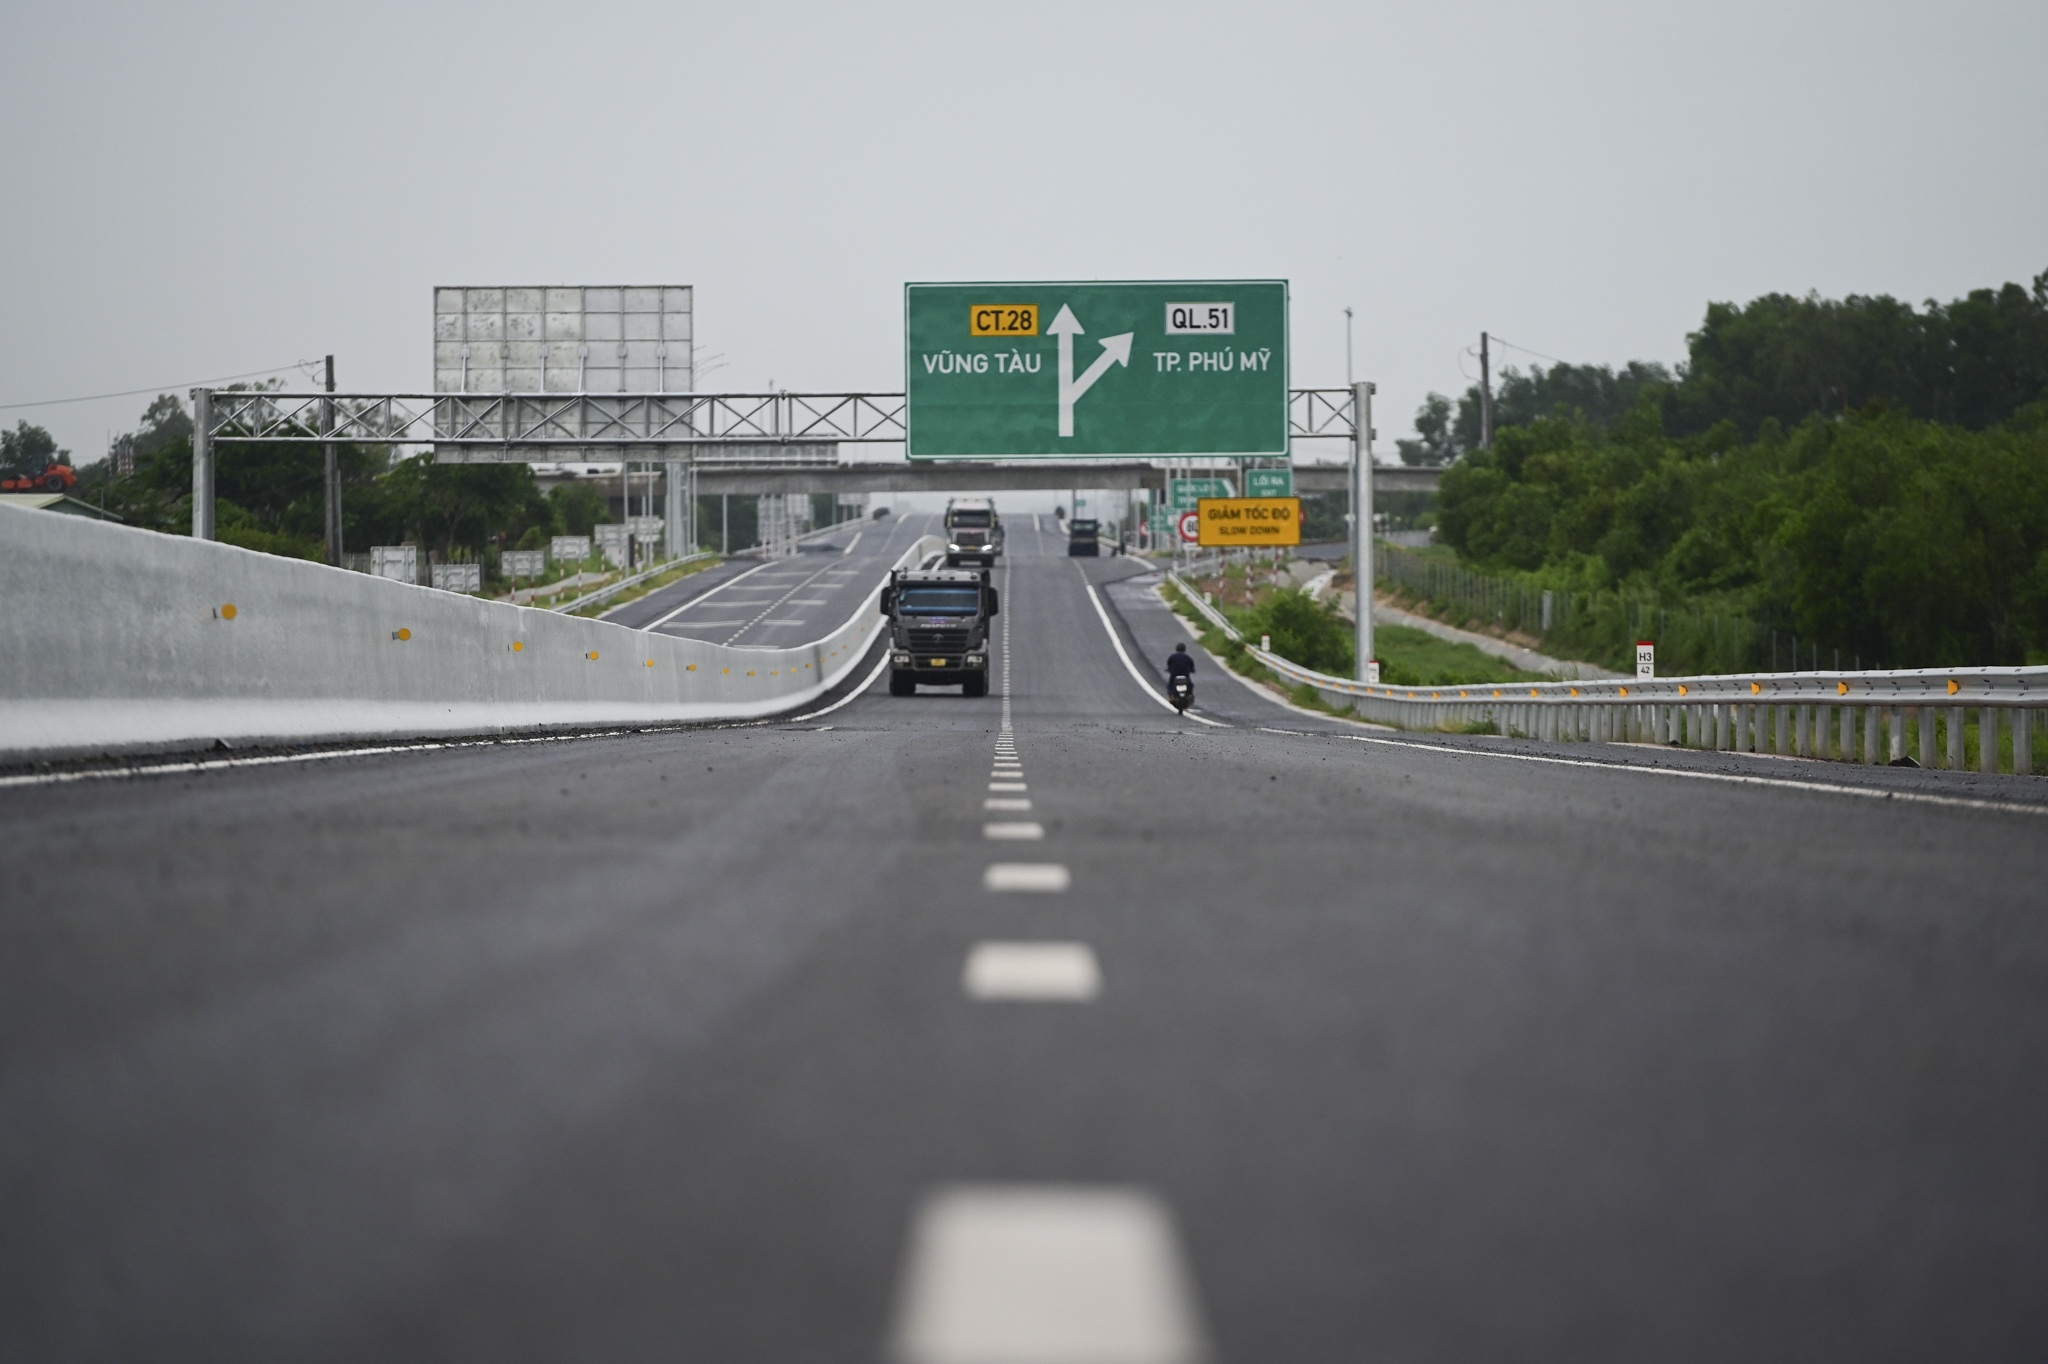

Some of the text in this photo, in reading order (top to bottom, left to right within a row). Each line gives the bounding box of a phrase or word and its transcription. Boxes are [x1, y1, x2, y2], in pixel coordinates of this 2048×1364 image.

[976, 310, 1033, 331] CT.28
[1172, 308, 1228, 329] QL.51
[922, 348, 1041, 374] VŨNG TÀU
[1152, 346, 1272, 372] TP. PHÚ MỸ
[1207, 503, 1291, 521] GIẢM TỐC ĐỘ
[1219, 526, 1280, 535] SLOW DOWN
[1639, 652, 1652, 661] H3
